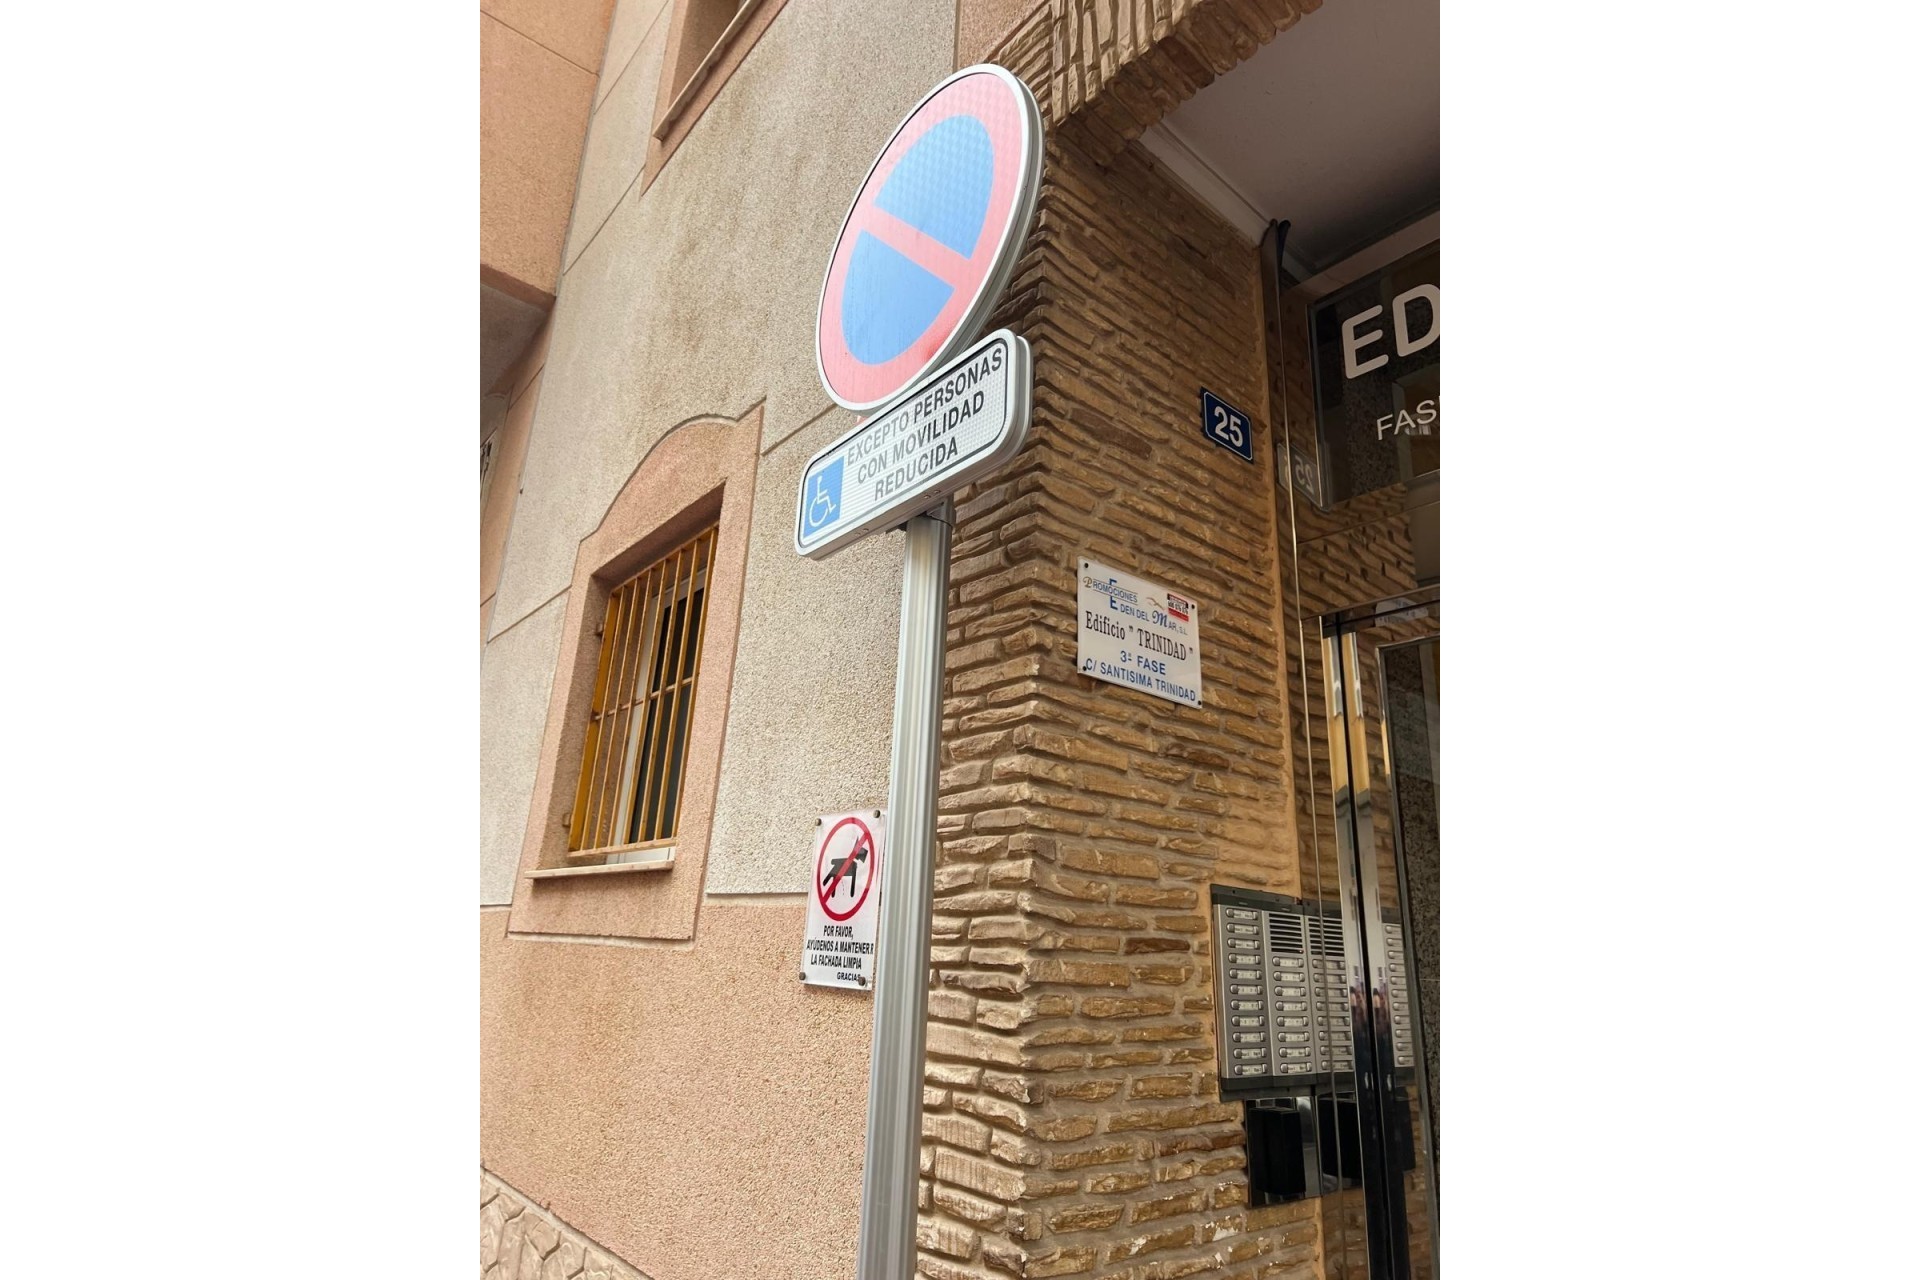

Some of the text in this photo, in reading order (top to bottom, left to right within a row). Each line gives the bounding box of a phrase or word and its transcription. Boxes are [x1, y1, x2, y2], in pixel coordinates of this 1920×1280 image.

[847, 348, 1002, 466] EXCEPTO PERSONAS
[1214, 406, 1244, 448] 25
[1377, 395, 1440, 440] FAS
[857, 390, 985, 484] CON MOVILIDAD
[874, 436, 958, 501] REDUCIDA
[1083, 576, 1138, 603] PROMOCIONES
[1085, 611, 1126, 640] Edificio
[1137, 628, 1187, 661] TRINIDAD
[1136, 609, 1150, 622] DEL
[1085, 658, 1196, 702] C/ SANTISIMA TRINIDAD
[1137, 655, 1166, 675] FASE
[824, 926, 853, 939] POR FAVOR,
[834, 942, 839, 952] A
[811, 954, 861, 969] LA FACHADA LIMPIA
